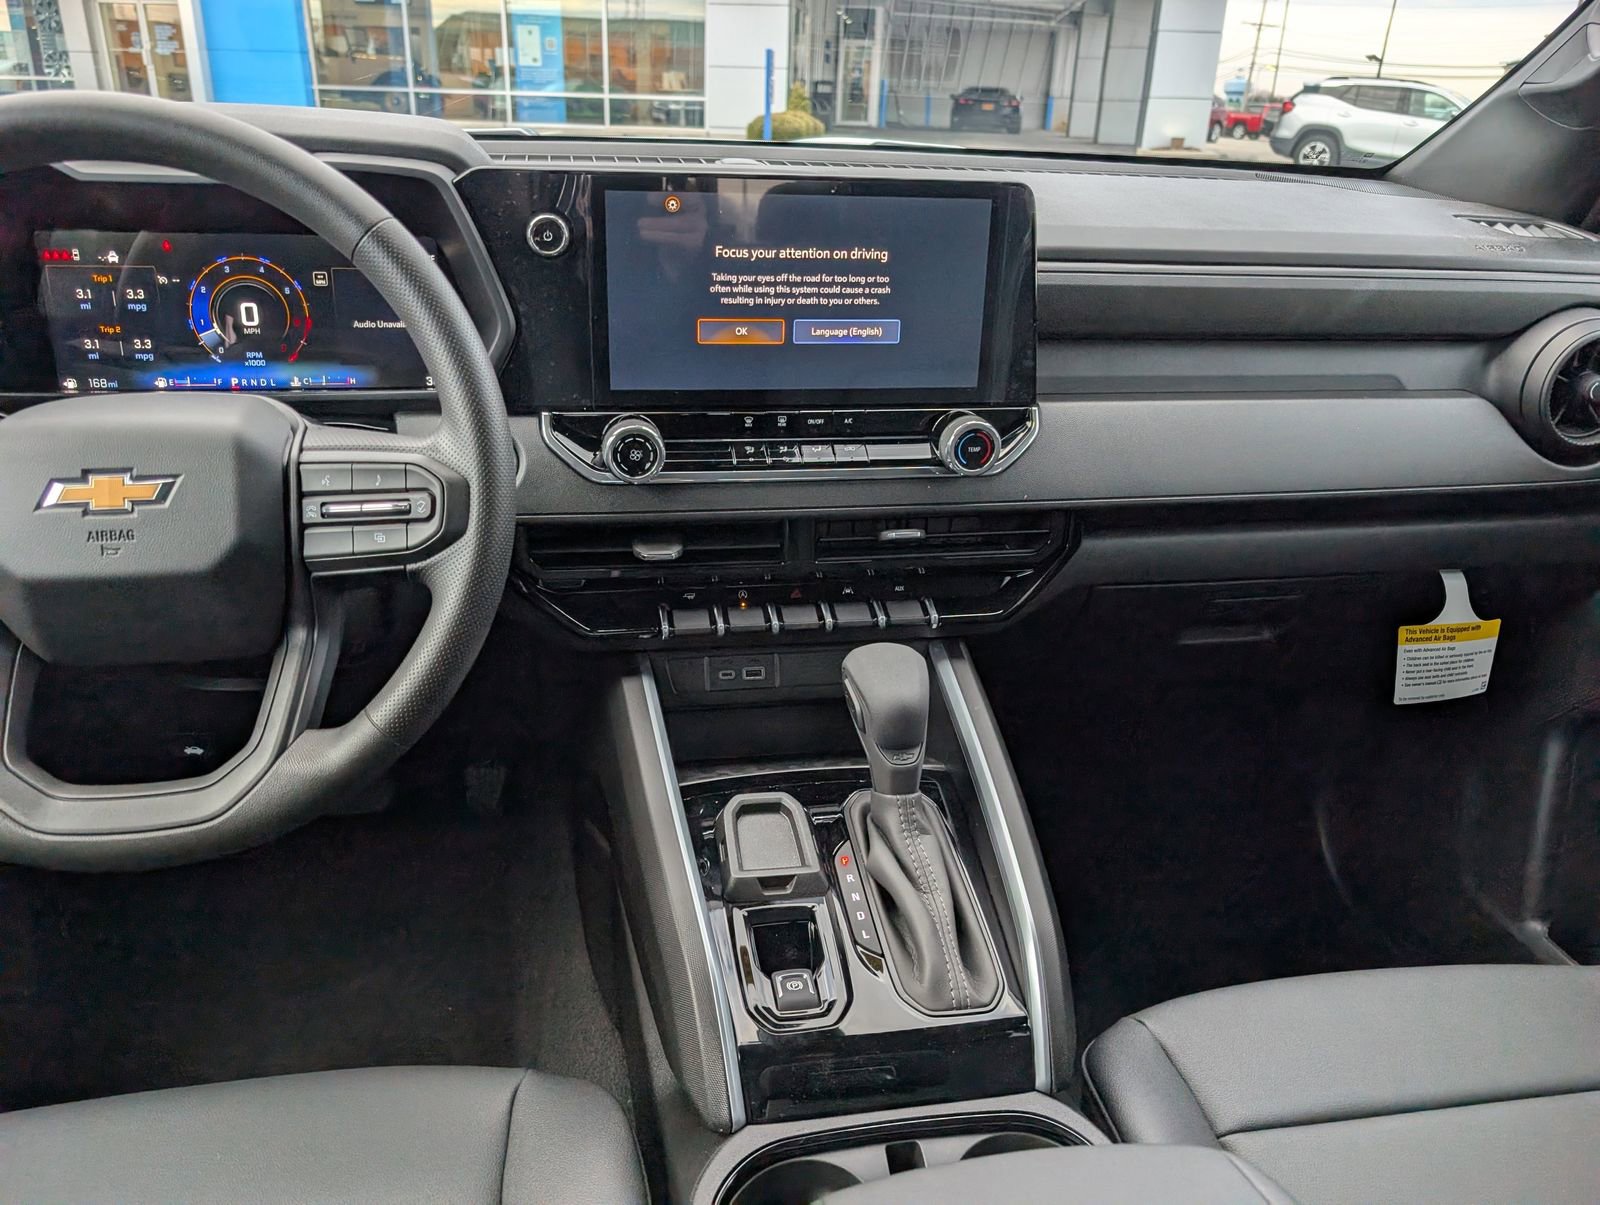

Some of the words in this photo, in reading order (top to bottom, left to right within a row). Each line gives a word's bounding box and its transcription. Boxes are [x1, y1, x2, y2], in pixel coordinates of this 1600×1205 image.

[715, 246, 748, 258] Focus
[750, 248, 777, 261] your
[779, 248, 830, 260] attention
[833, 250, 848, 260] on
[850, 248, 888, 262] driving
[92, 274, 108, 283] Trip
[712, 272, 737, 283] Taking
[738, 274, 756, 284] your
[757, 274, 775, 284] eyes
[776, 274, 789, 282] off
[789, 274, 802, 282] the
[803, 274, 821, 282] road
[822, 274, 833, 282] for
[849, 275, 865, 284] long
[76, 289, 92, 299] 3.1
[126, 289, 145, 299] 3.3
[710, 284, 731, 293] often
[732, 284, 753, 293] while
[754, 285, 775, 294] using
[776, 285, 790, 293] this
[791, 286, 818, 295] system
[820, 285, 840, 294] could
[870, 286, 890, 294] crash
[720, 296, 754, 306] resulting
[764, 296, 786, 306] injury
[796, 297, 819, 305] death
[829, 298, 843, 306] you
[854, 297, 880, 305] others.
[128, 303, 147, 312] mpg
[240, 302, 259, 326] 0
[100, 326, 115, 334] Trip
[735, 327, 748, 336] OK
[811, 328, 848, 338] Language
[849, 327, 883, 338] (English)
[84, 339, 100, 349] 3.1
[134, 339, 152, 349] 3.3
[135, 353, 154, 361] mpg
[232, 378, 238, 386] P
[87, 529, 135, 542] AIRBAG
[1447, 626, 1470, 634] Equipped
[846, 874, 855, 883] R
[851, 892, 860, 901] N
[857, 912, 865, 920] D
[862, 930, 870, 938] L
